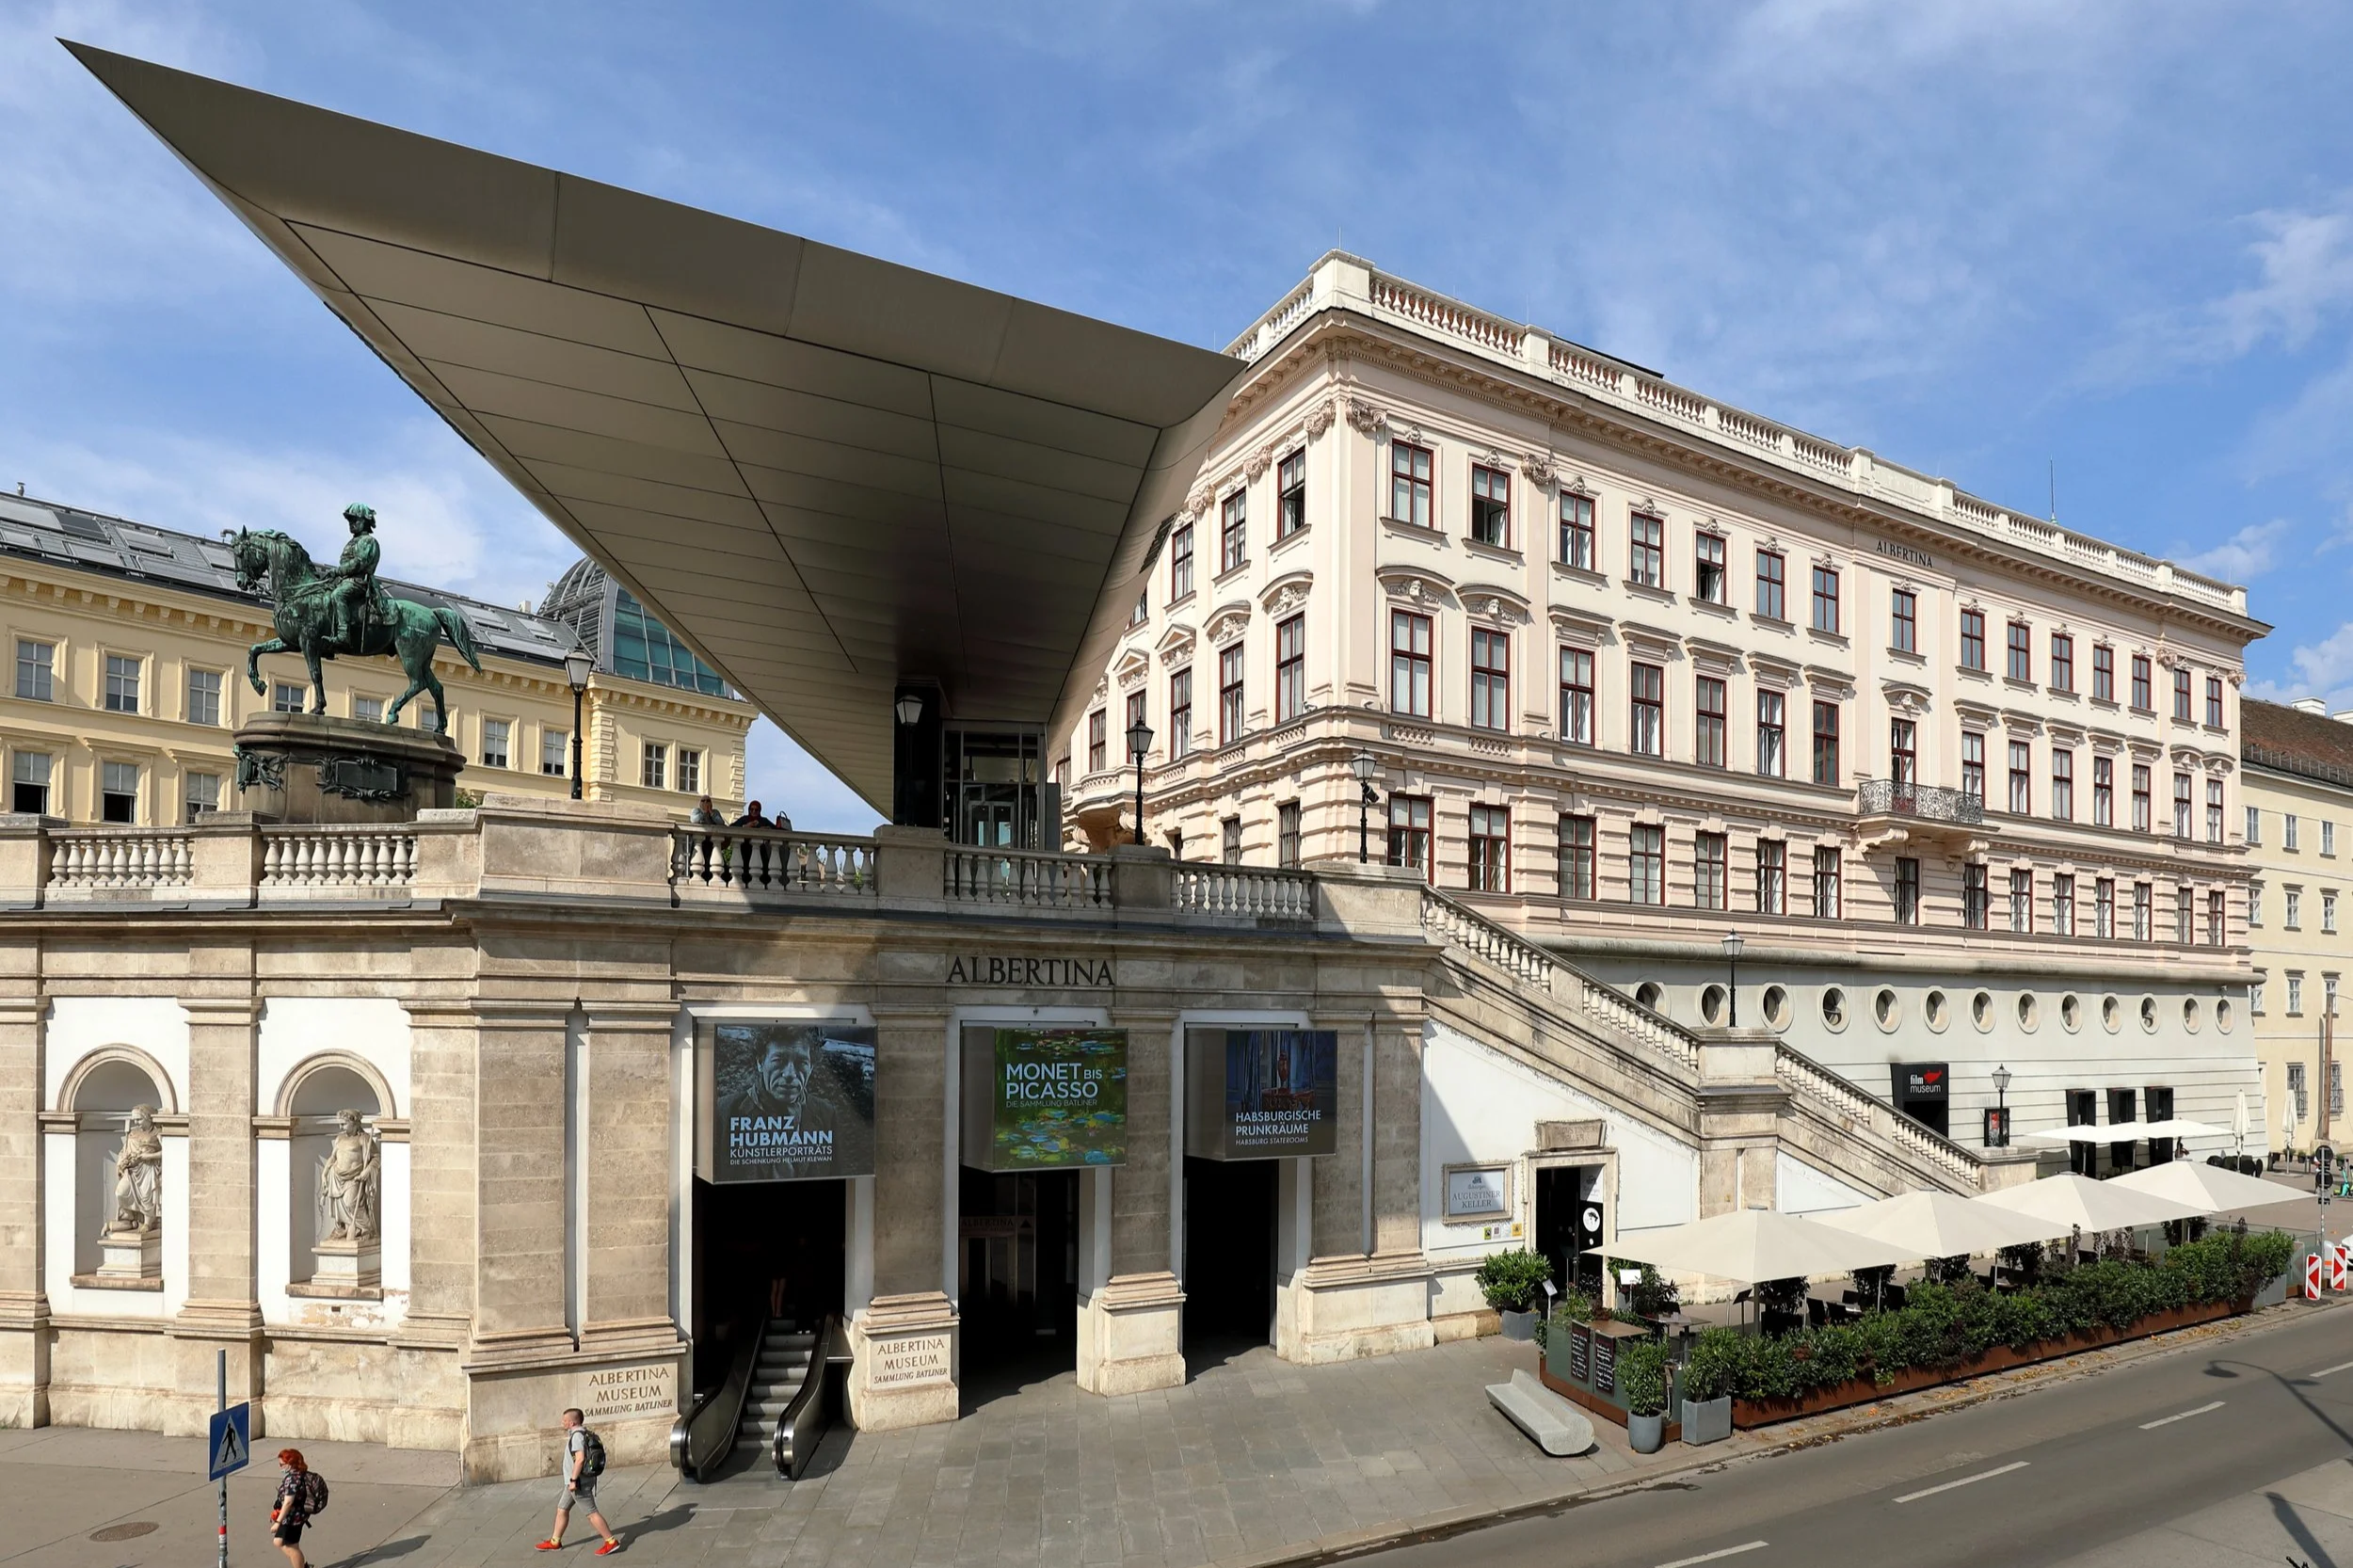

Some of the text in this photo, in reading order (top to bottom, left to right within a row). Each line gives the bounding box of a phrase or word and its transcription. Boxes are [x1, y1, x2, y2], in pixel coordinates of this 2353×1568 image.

[945, 955, 1115, 986] ALBERTINA
[1005, 1062, 1103, 1080] MONET BIS
[1910, 1074, 1924, 1085] film
[1005, 1080, 1098, 1099] PICASSO
[1910, 1085, 1941, 1094] museum
[1005, 1098, 1097, 1109] DIE SAMMLUNG BATLINER
[729, 1115, 795, 1131] FRANZ
[1235, 1110, 1321, 1123] HABSBURGISCHE
[1235, 1121, 1309, 1136] PRUNKRÄUME
[729, 1130, 833, 1147] HUBMANN
[1235, 1136, 1308, 1145] HABSBURG STATEROOMS
[729, 1144, 833, 1159] KÜNSTLERPORTRÄTS
[1452, 1190, 1501, 1201] AUGUSTINER
[1462, 1200, 1492, 1208] KELLER
[877, 1338, 944, 1355] ALBERTINA
[884, 1353, 938, 1370] MUSEUM
[588, 1368, 669, 1386] ALBERTINA
[873, 1368, 948, 1384] SAMMLUNG BATLINER
[596, 1384, 662, 1402] MUSEUM
[584, 1399, 673, 1417] SAMMLUNG BATLINER
